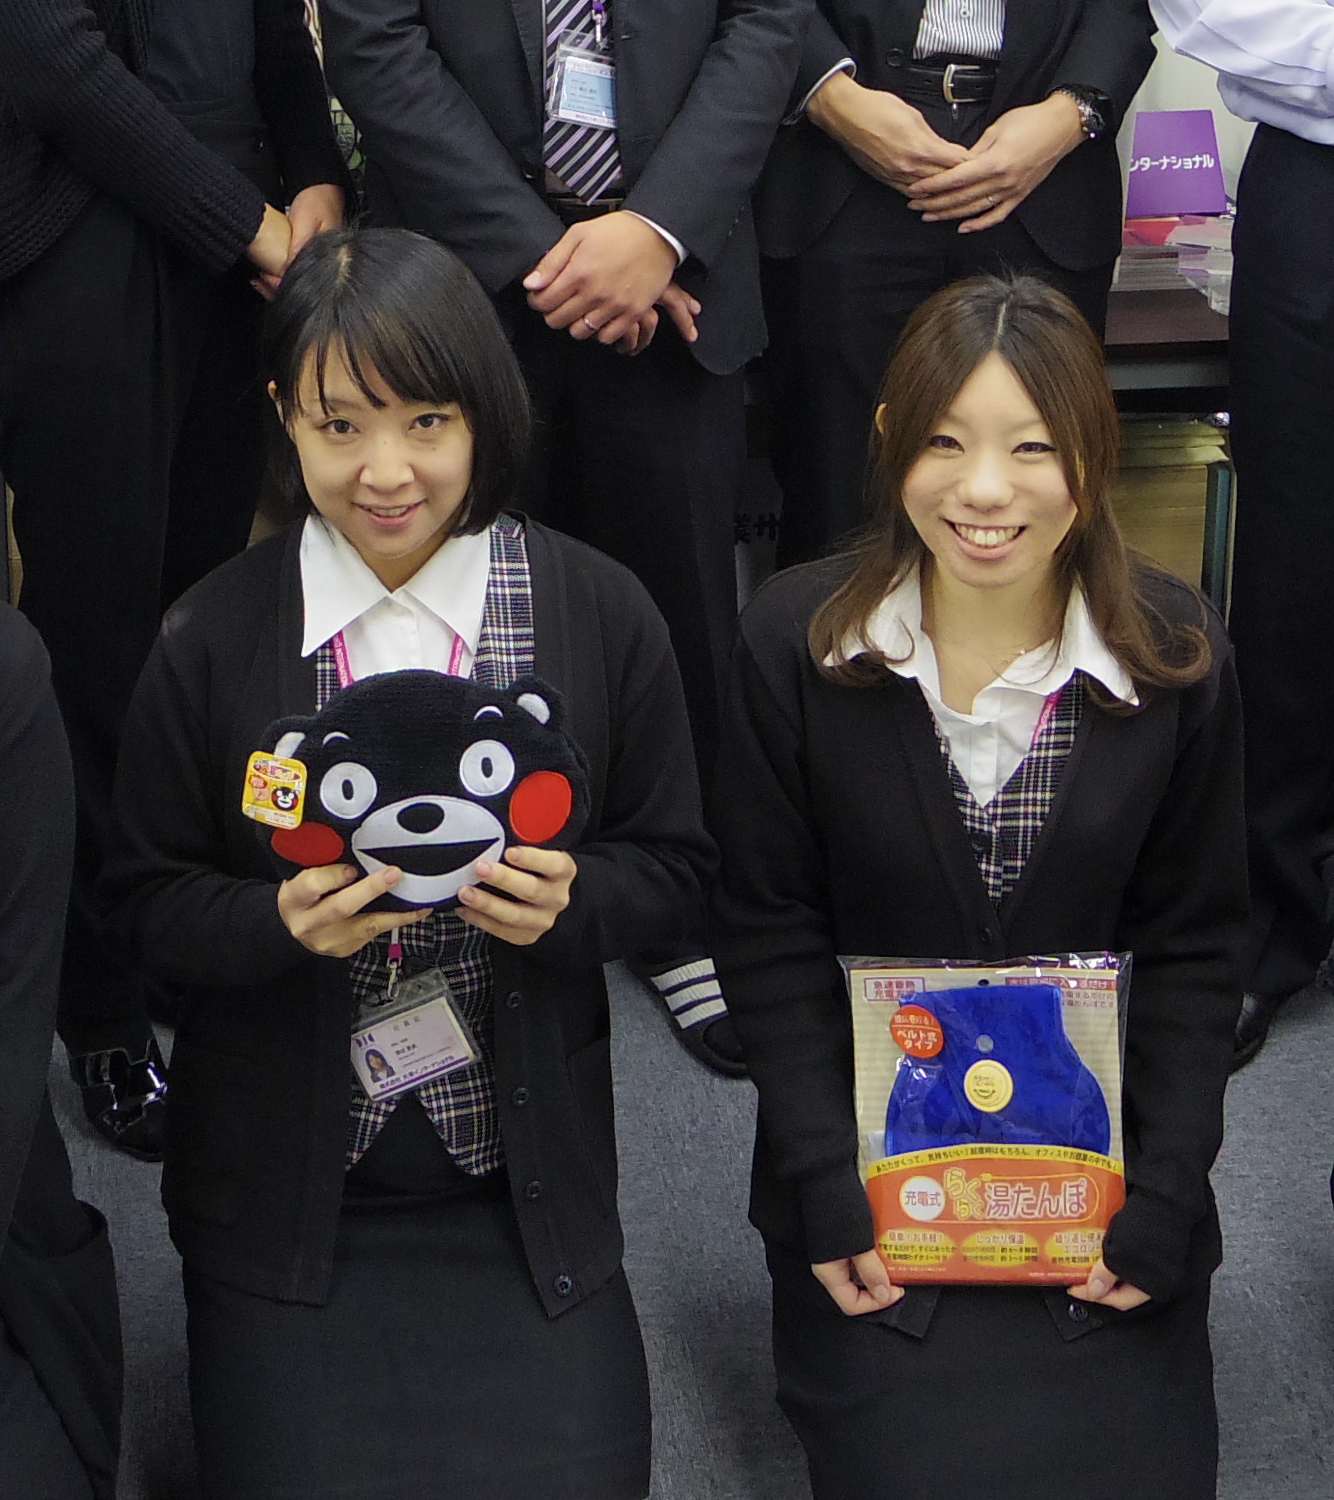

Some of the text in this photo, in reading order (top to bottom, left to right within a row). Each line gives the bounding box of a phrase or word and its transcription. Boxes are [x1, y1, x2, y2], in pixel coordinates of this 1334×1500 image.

[1130, 154, 1215, 172] ンターナショナル
[904, 1190, 942, 1207] 充電式
[985, 1179, 1087, 1218] 湯たんぽ
